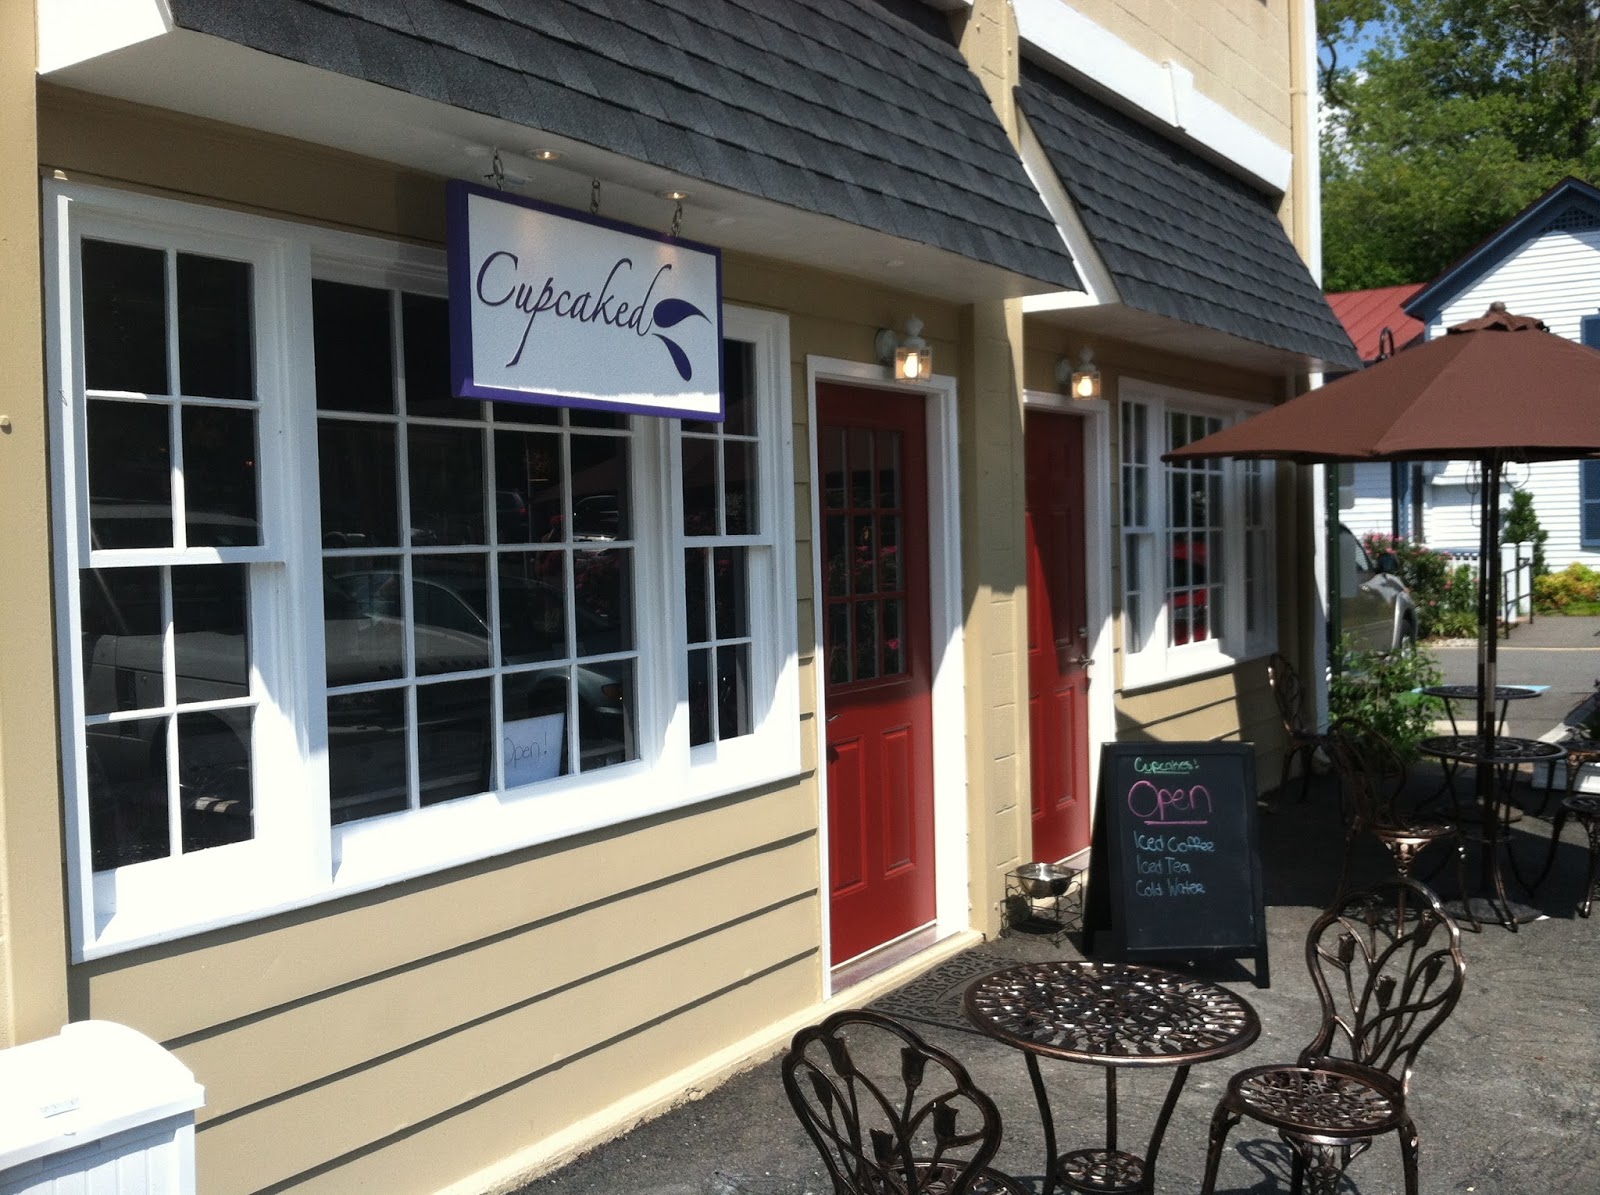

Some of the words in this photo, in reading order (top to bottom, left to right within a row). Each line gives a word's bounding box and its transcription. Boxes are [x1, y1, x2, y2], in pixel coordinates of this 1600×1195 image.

[476, 250, 673, 368] Cupcaked
[503, 731, 548, 769] Open!
[1128, 780, 1212, 821] Open
[1133, 830, 1164, 851] Iced
[1167, 836, 1215, 852] Coffee
[1136, 854, 1163, 874] Iced
[1165, 856, 1191, 874] Tea
[1135, 879, 1163, 897] Cold
[1167, 878, 1206, 897] Water
